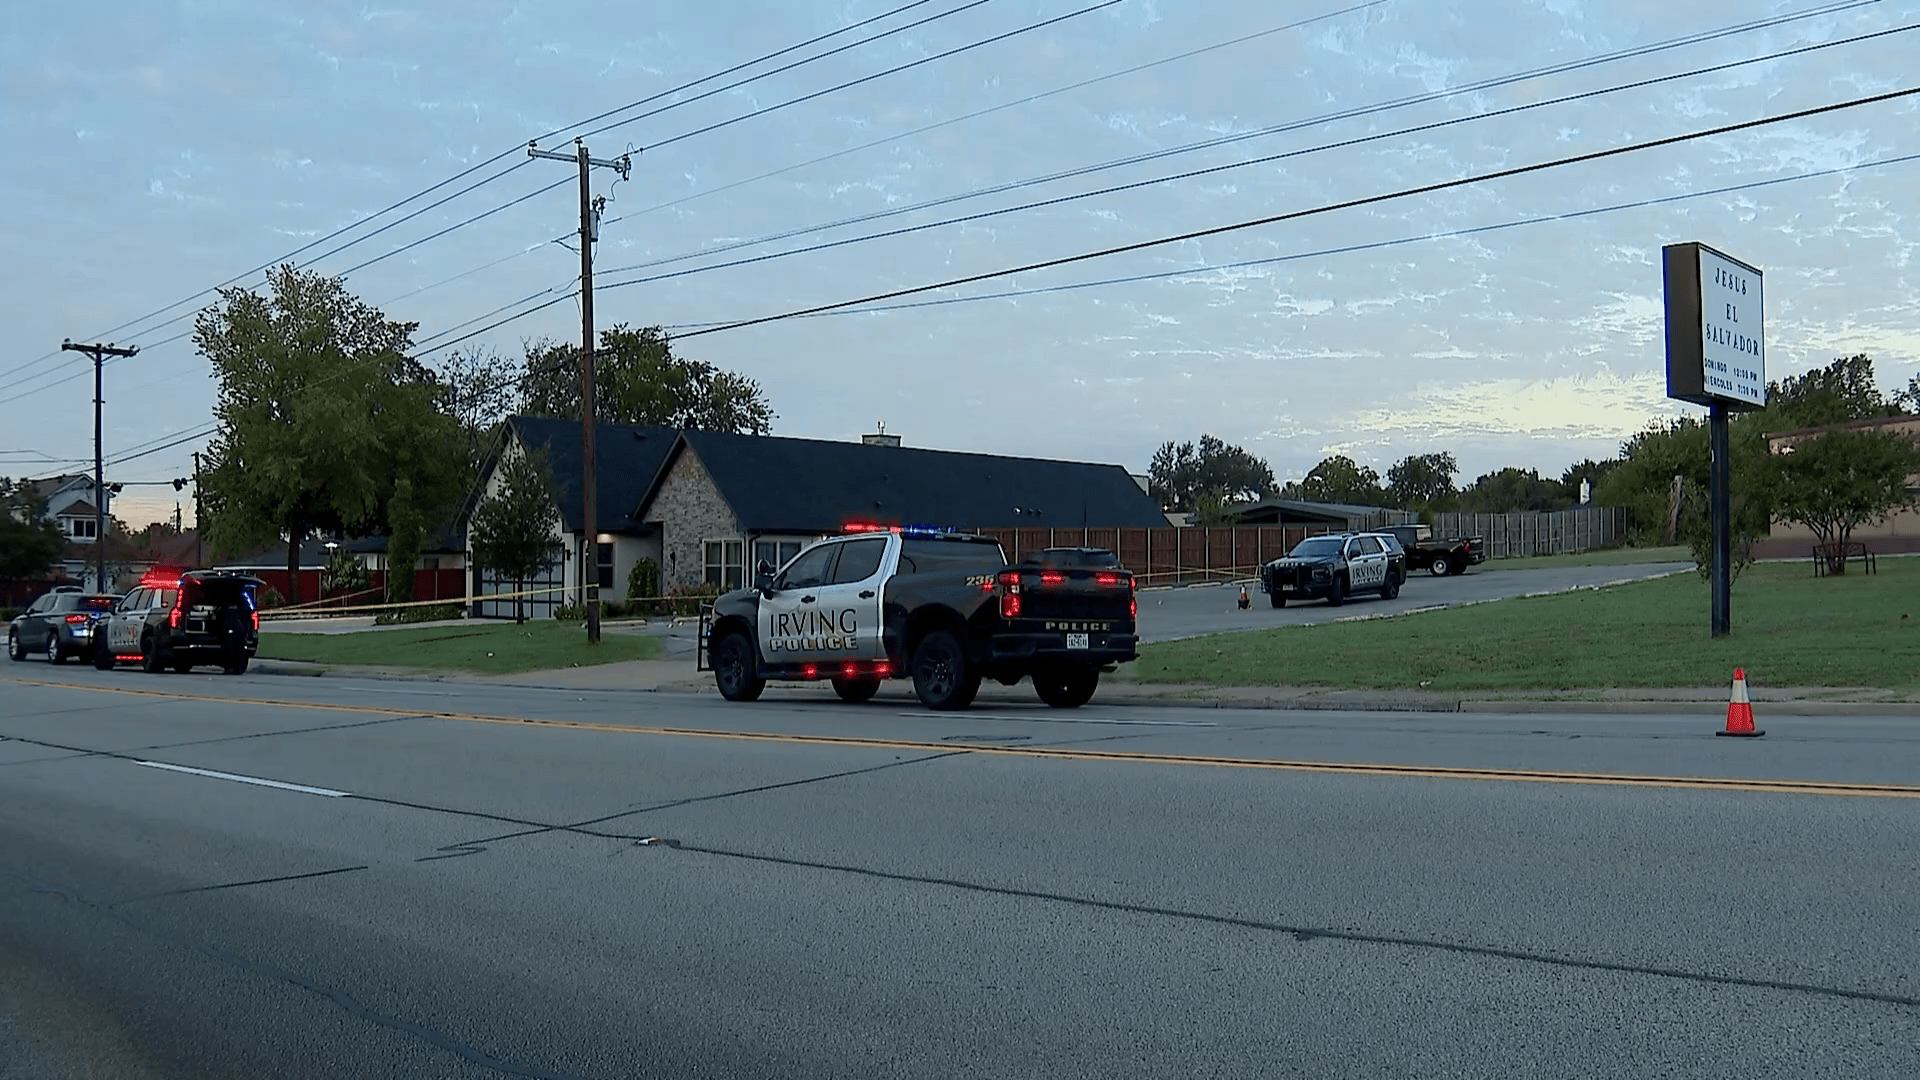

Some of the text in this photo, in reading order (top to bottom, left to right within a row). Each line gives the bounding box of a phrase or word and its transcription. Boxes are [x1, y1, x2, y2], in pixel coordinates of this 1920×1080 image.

[1715, 267, 1746, 295] JESUS
[1726, 303, 1738, 323] EL
[1706, 323, 1759, 356] SALVADOR
[1705, 358, 1728, 373] DOMINGO
[1750, 371, 1757, 381] PM
[1751, 388, 1758, 398] PM
[1352, 564, 1383, 581] IRVING
[770, 608, 857, 637] IRVING
[1045, 621, 1111, 631] POLICE
[769, 636, 859, 652] POLICE
